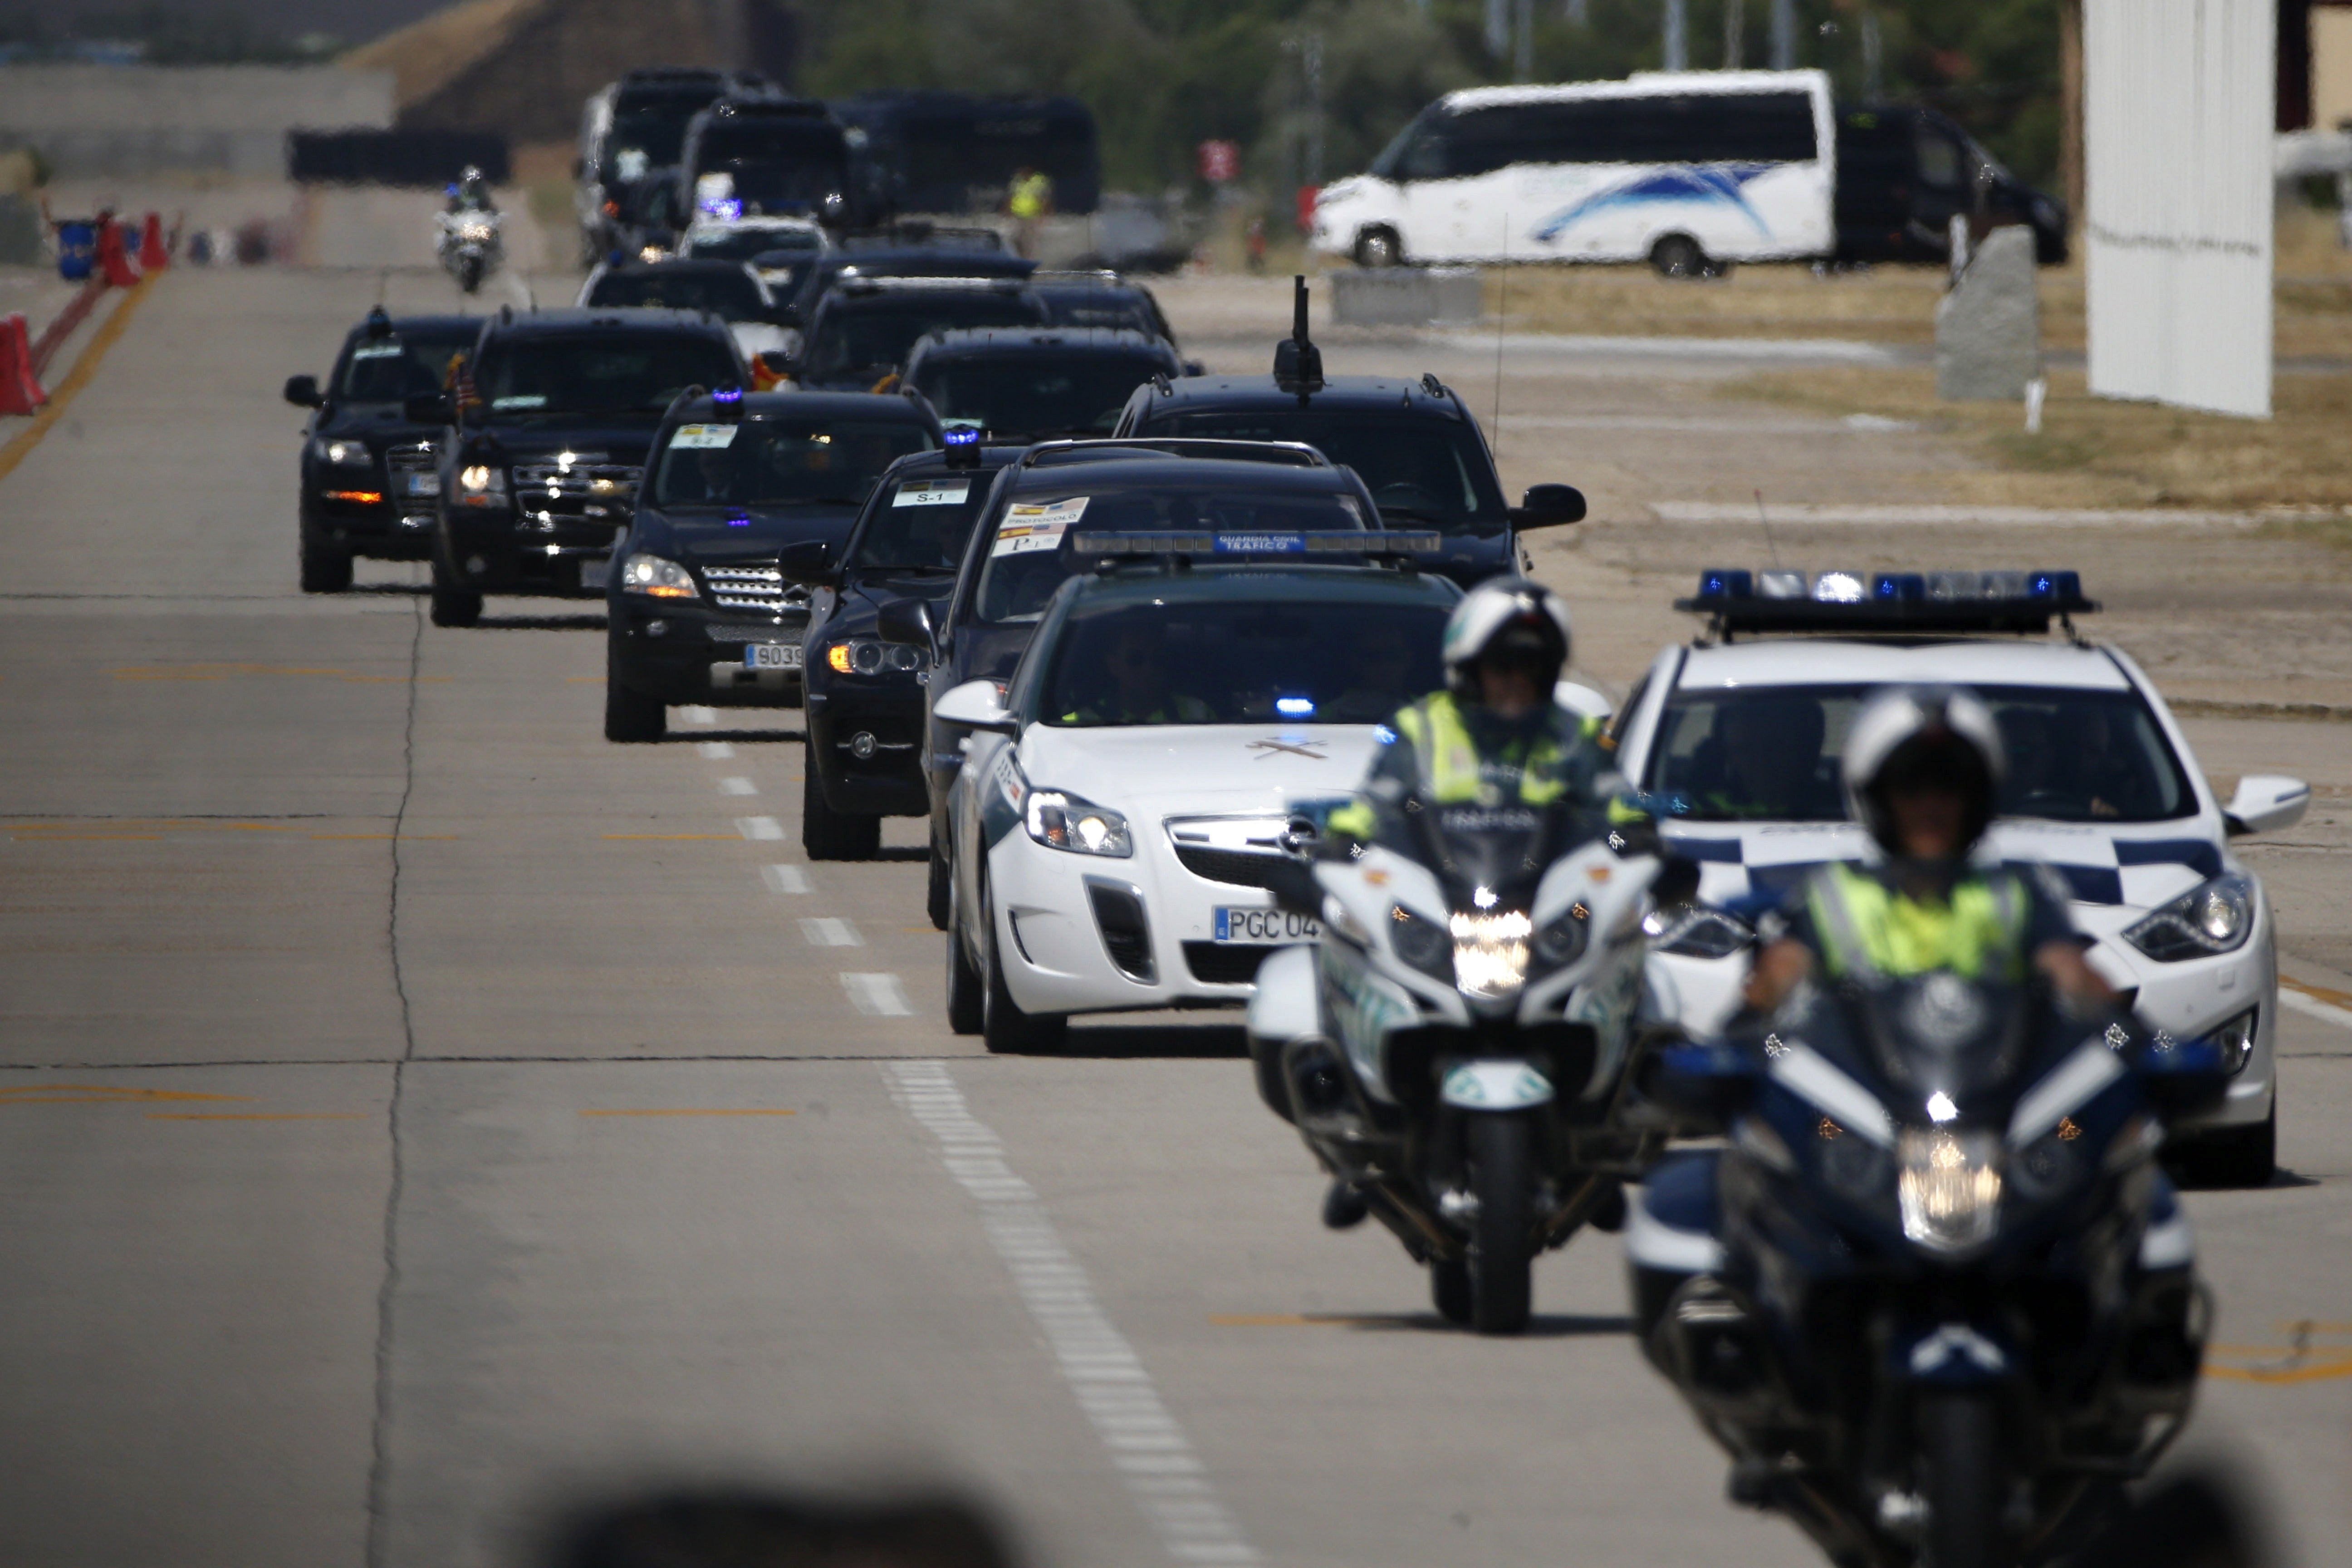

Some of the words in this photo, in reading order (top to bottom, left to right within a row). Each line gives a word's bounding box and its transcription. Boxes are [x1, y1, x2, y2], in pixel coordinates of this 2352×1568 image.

[917, 493, 944, 502] S-1
[1008, 514, 1077, 523] PROTOCOLO
[1230, 911, 1279, 938] PGC
